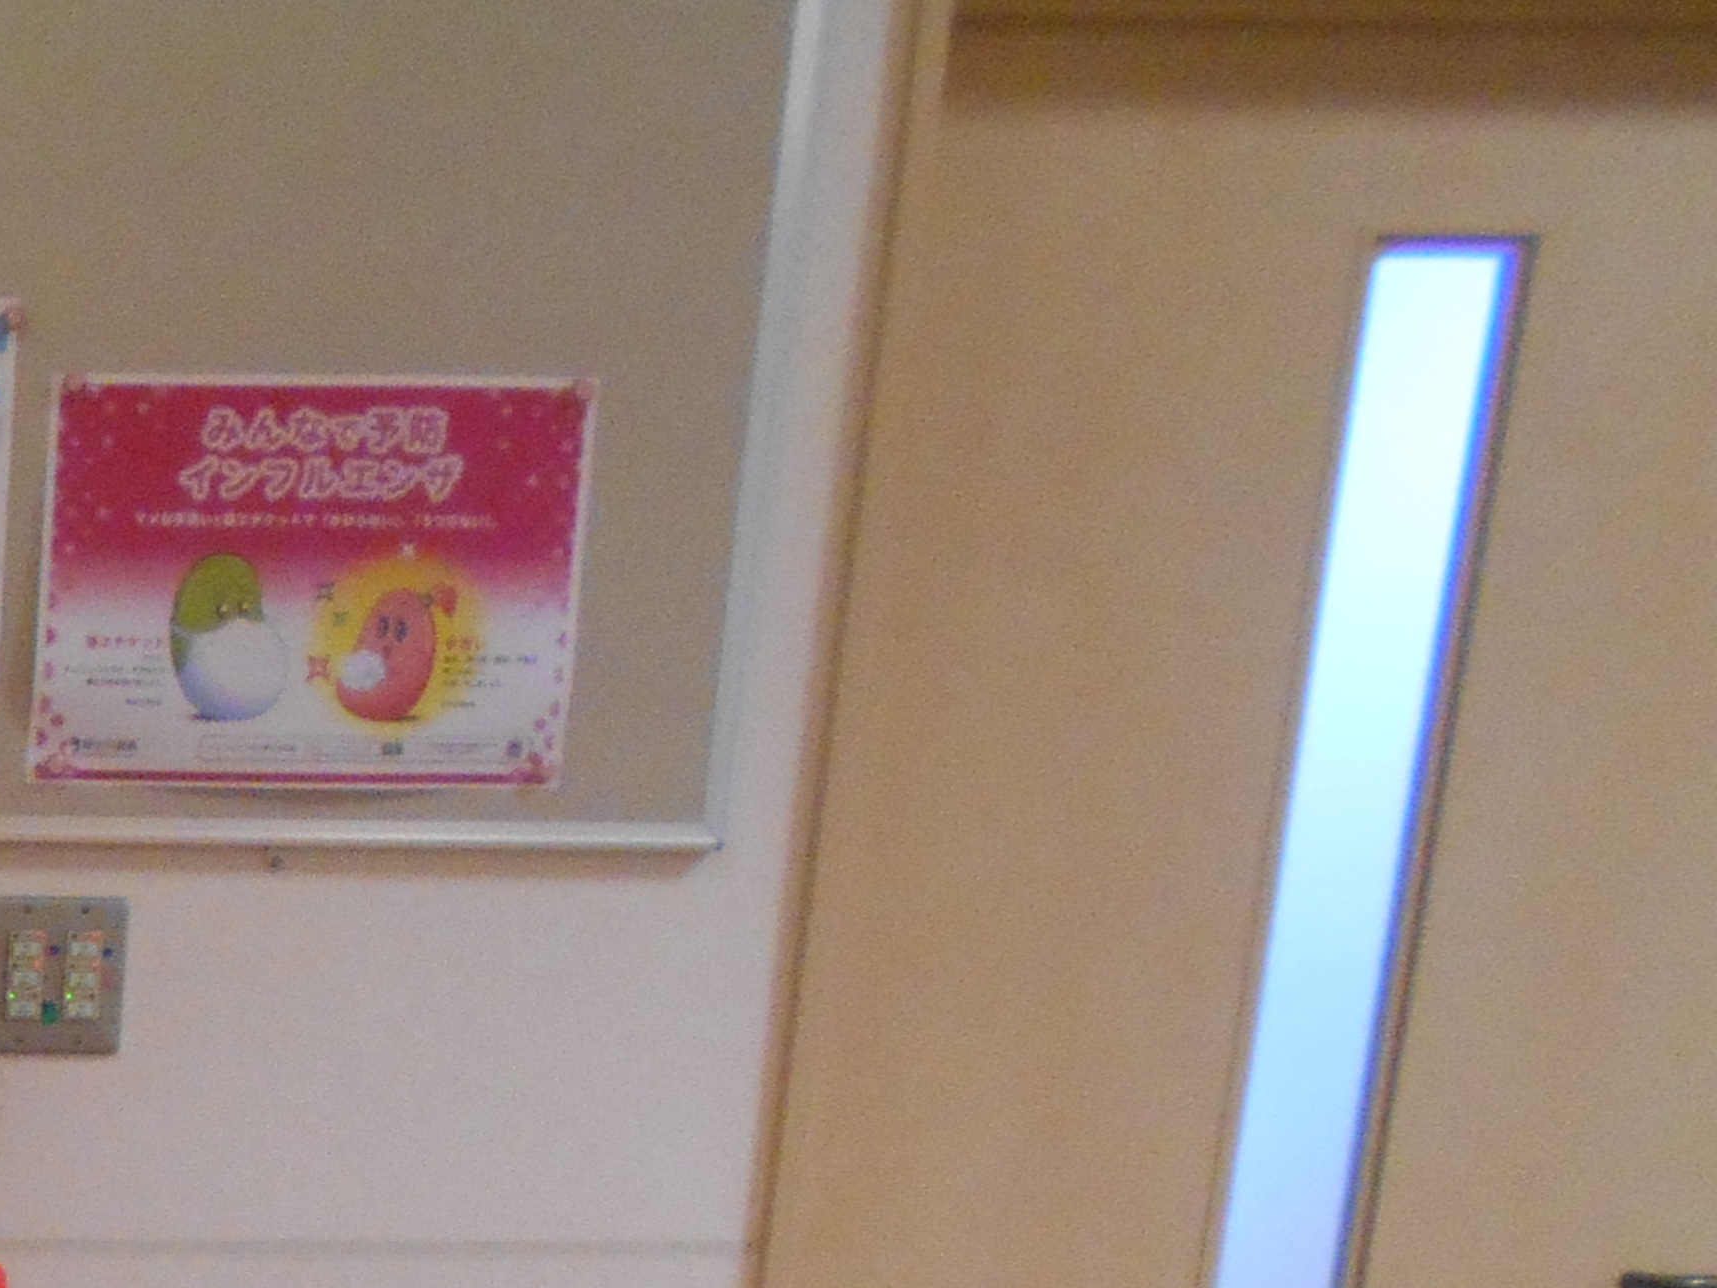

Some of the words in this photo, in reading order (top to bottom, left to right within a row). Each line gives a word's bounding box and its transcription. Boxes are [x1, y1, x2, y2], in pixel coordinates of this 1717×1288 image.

[202, 405, 449, 453] みんなで予防
[179, 453, 464, 502] インフルエンザ
